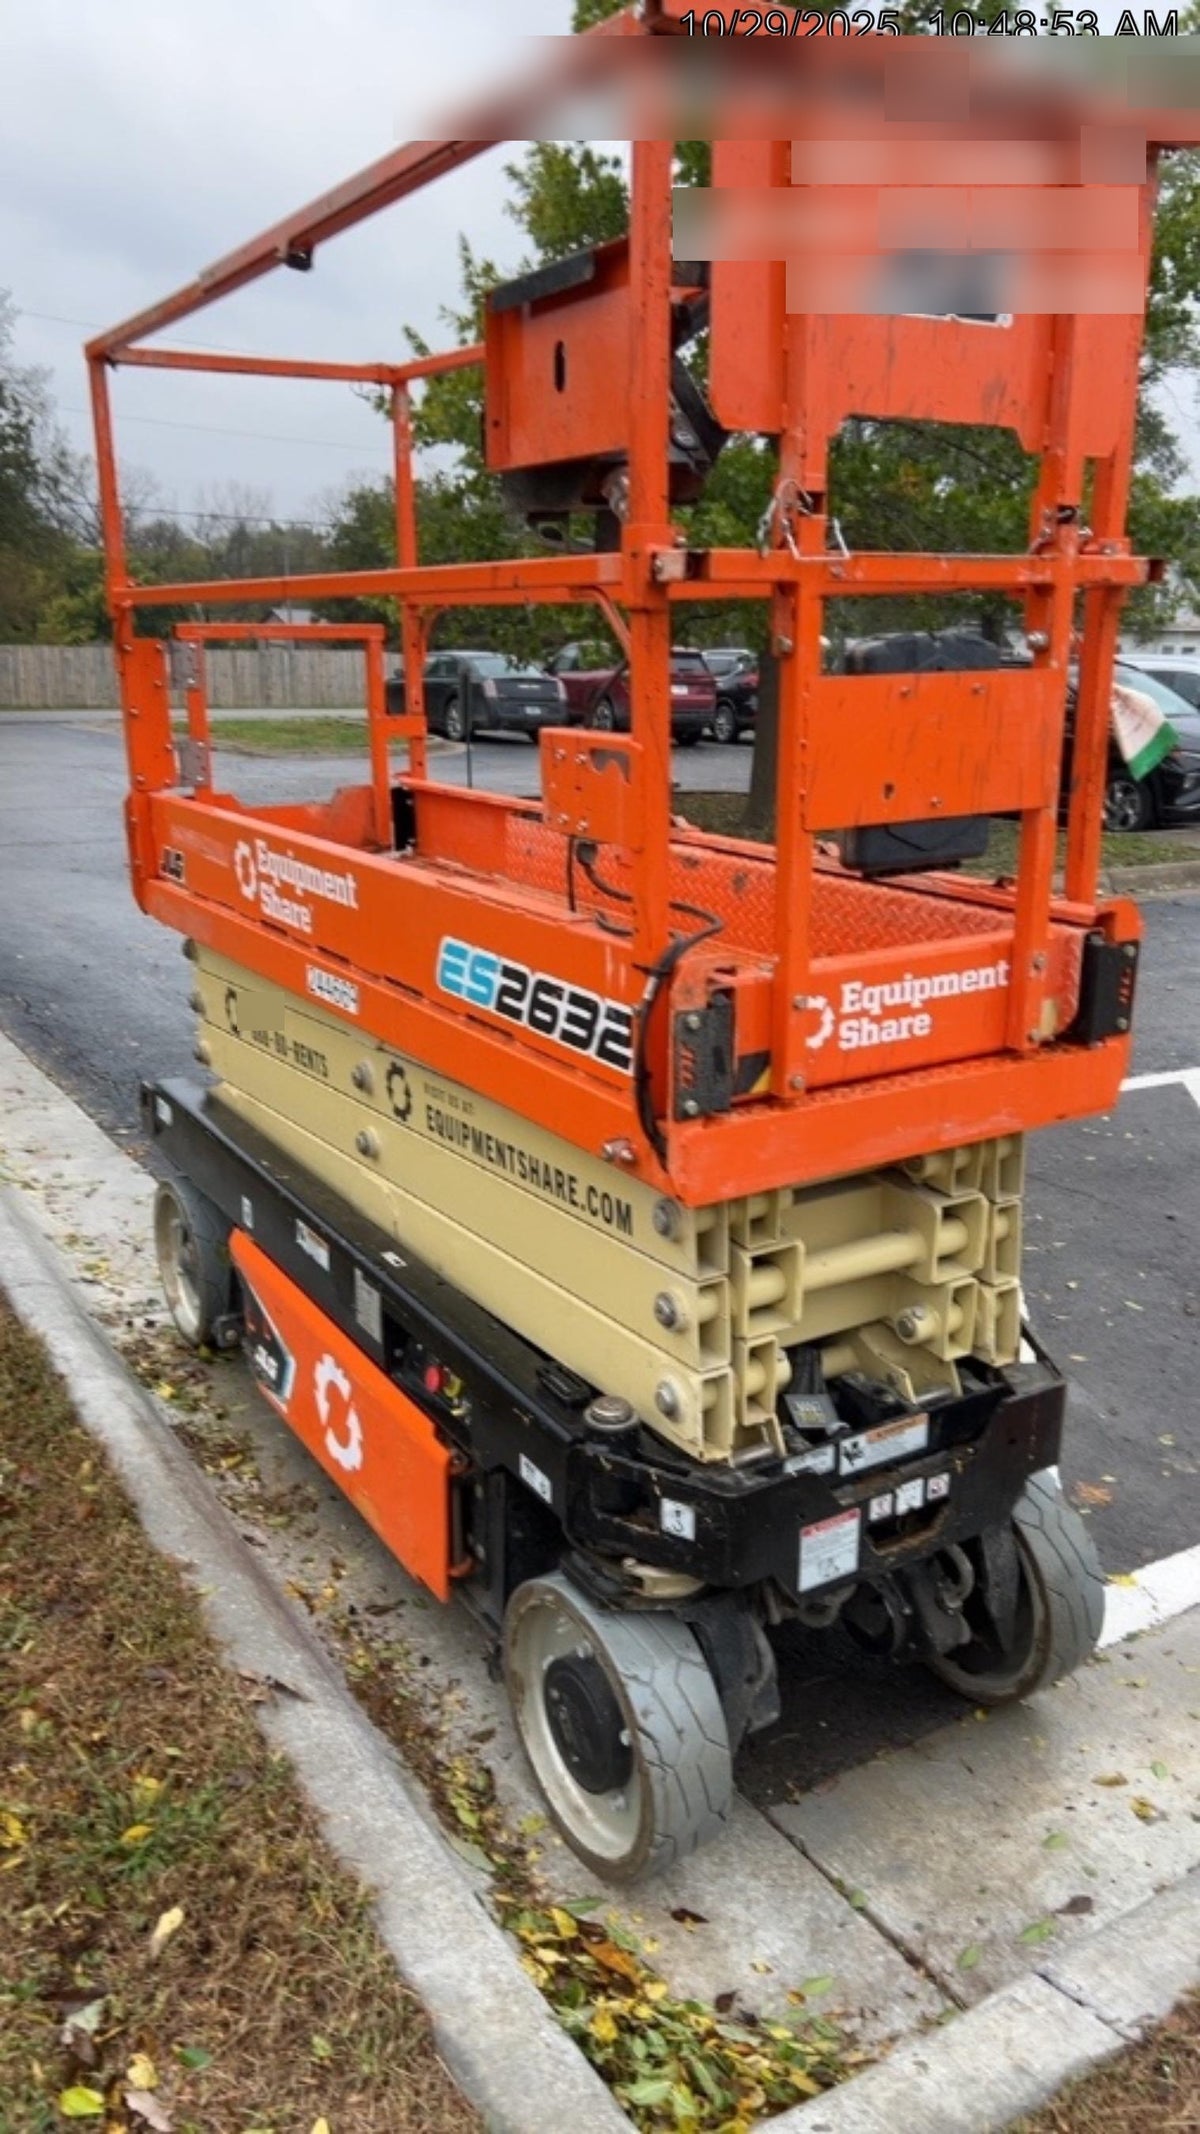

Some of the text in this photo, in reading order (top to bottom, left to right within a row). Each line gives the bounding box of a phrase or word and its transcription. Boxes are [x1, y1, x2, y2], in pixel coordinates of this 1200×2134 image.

[255, 839, 359, 910] Equipment
[260, 881, 312, 934] Share
[438, 938, 634, 1074] ES2632
[840, 960, 1010, 1016] Equipment
[838, 1012, 932, 1051] Share
[426, 1103, 634, 1236] EQUIPMENTSHARE.COM
